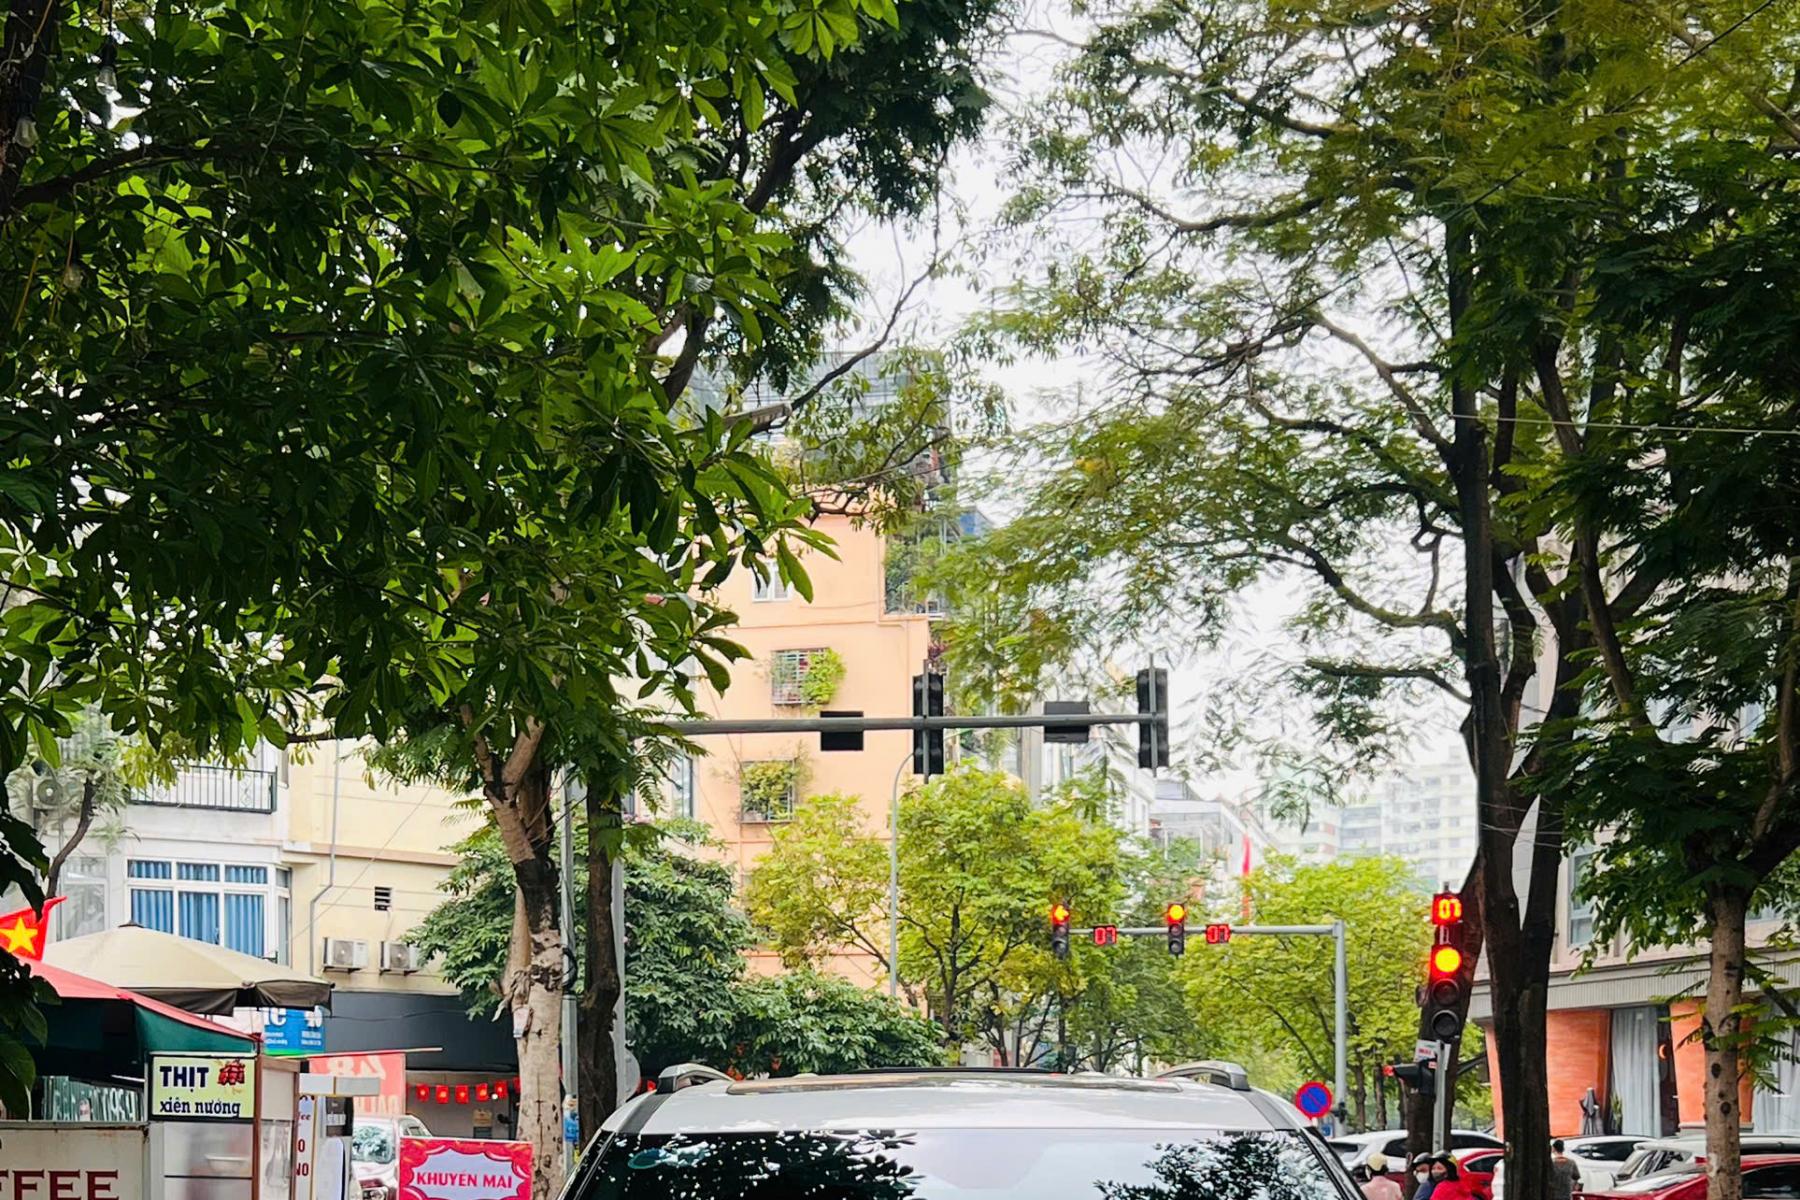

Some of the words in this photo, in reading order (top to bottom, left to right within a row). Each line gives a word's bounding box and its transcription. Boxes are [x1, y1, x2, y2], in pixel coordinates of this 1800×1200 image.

[1438, 898, 1462, 919] 07
[1094, 926, 1116, 945] 07
[1206, 925, 1230, 943] 07
[159, 1066, 209, 1093] THỊT
[160, 1096, 191, 1113] xiên
